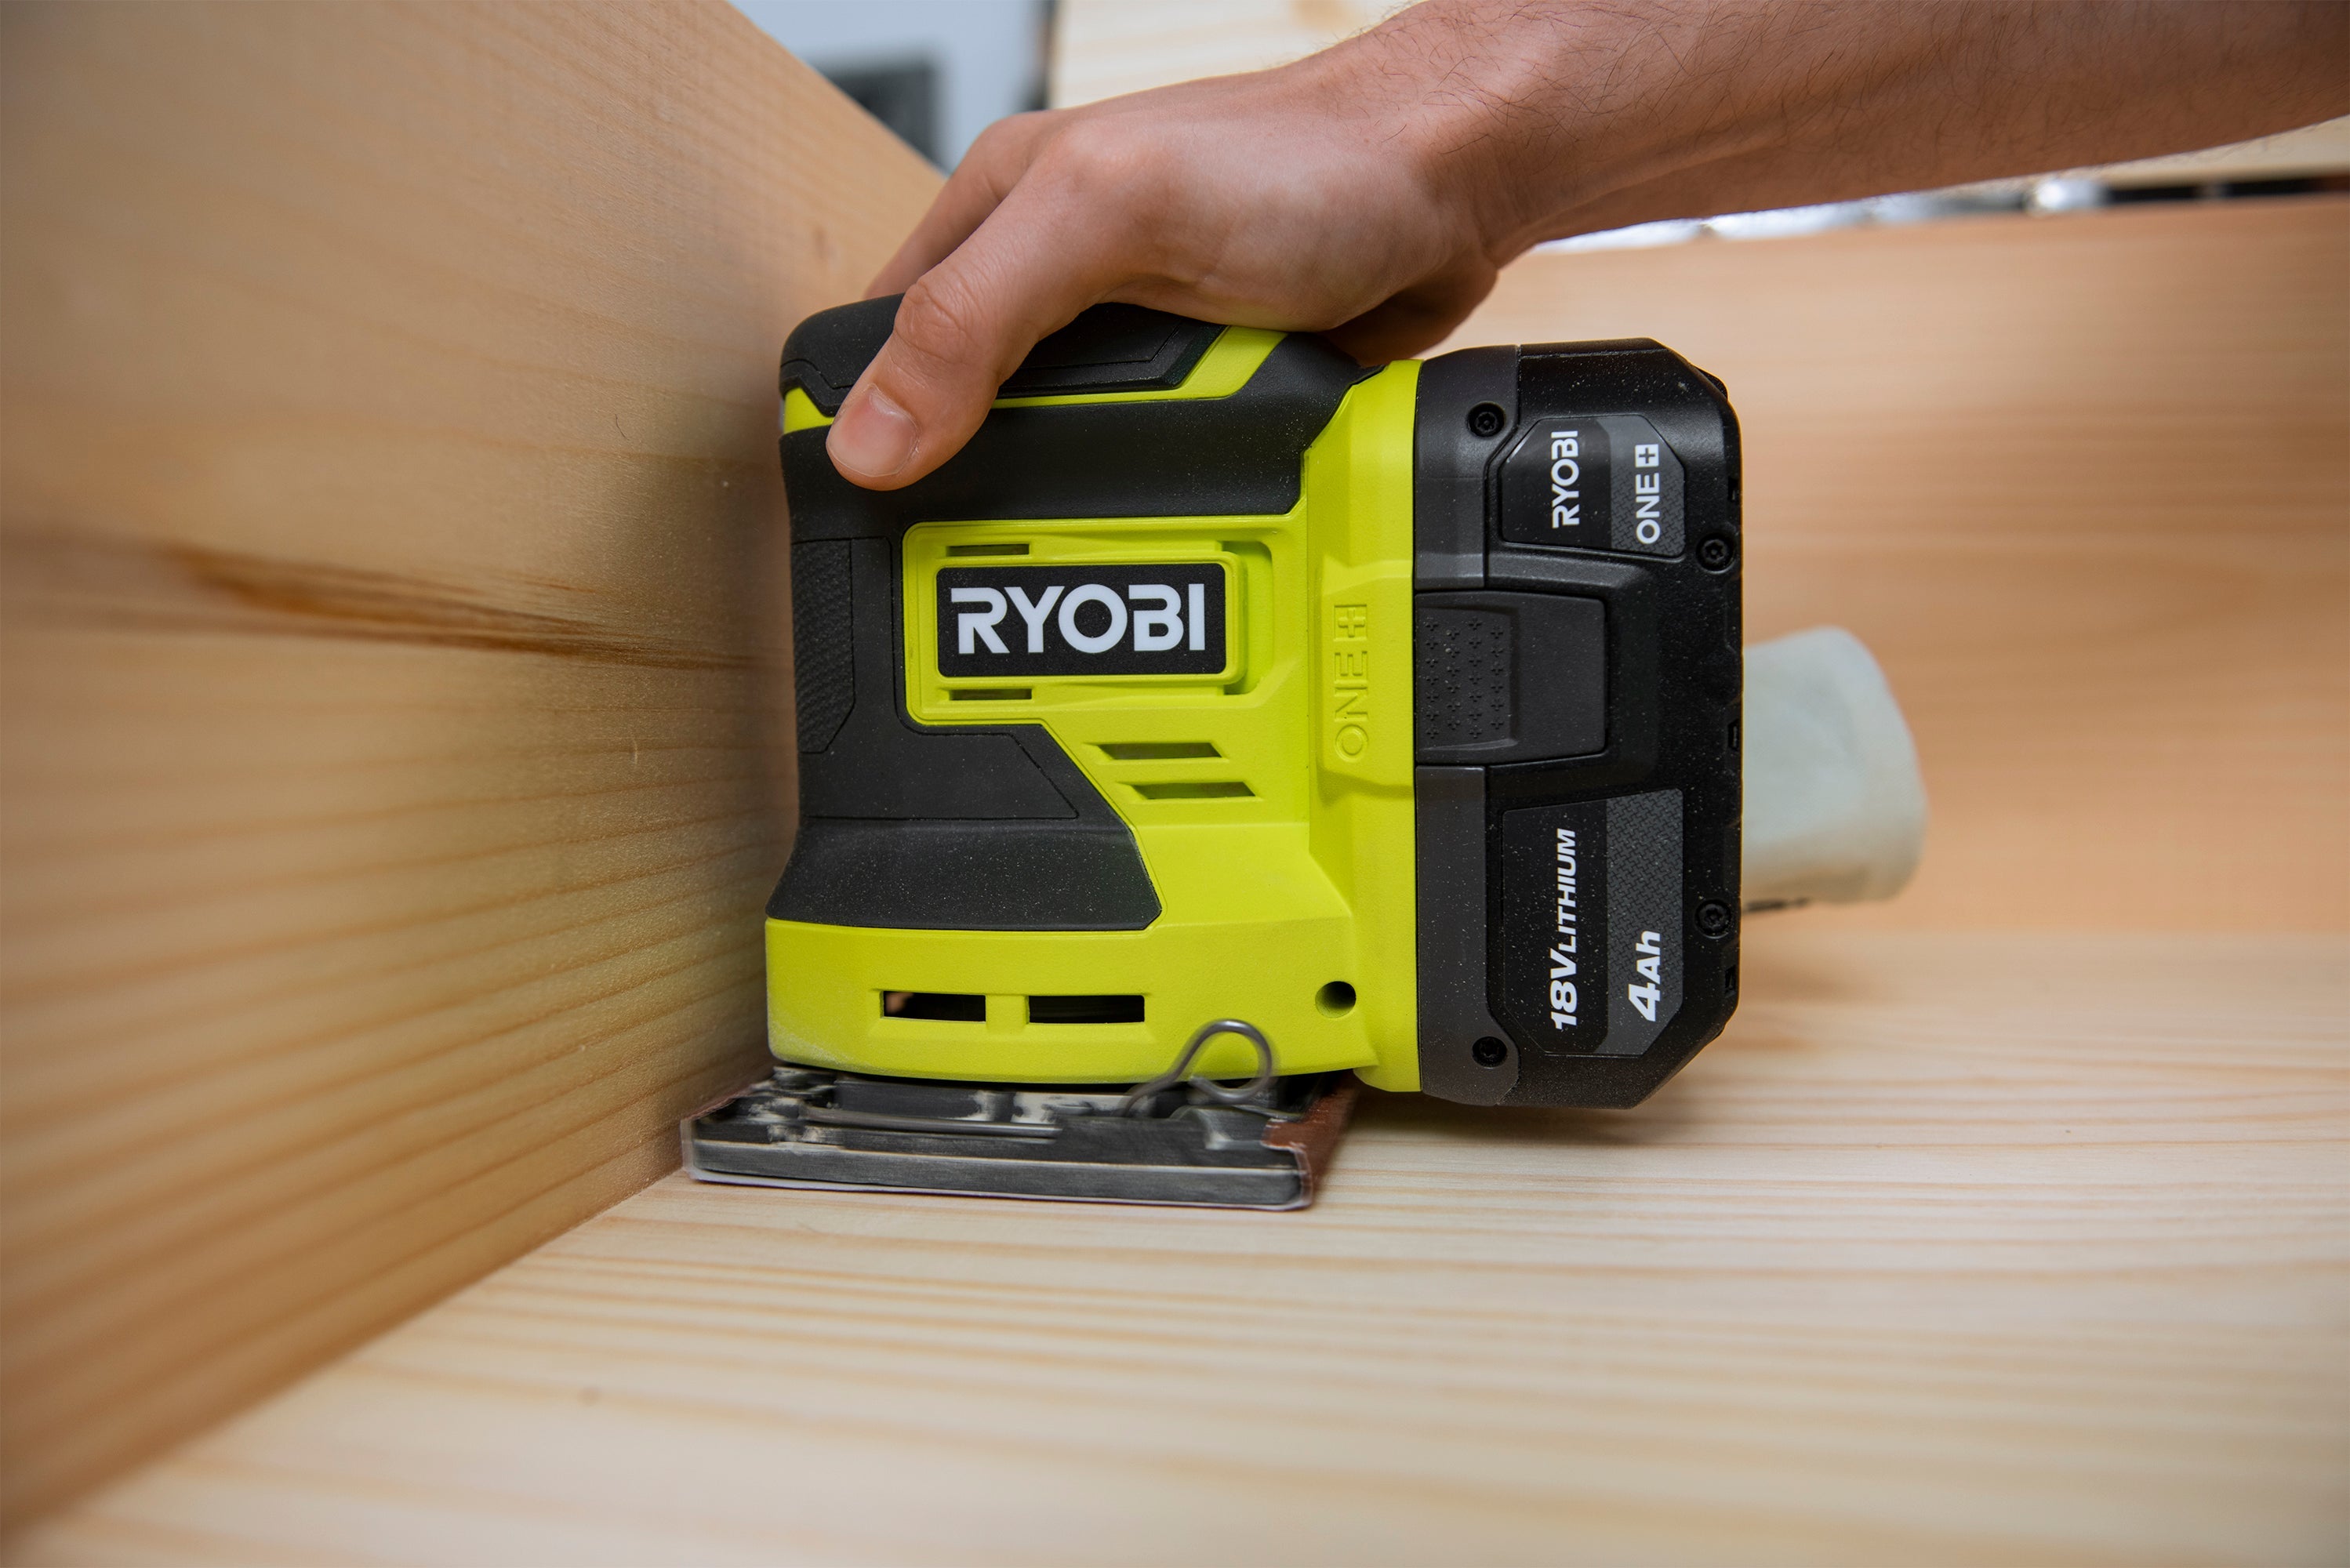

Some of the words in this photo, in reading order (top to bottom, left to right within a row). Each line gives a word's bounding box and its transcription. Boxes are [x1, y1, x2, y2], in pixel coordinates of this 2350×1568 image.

[1550, 430, 1580, 529] RYOBI
[951, 583, 1205, 654] RYOBI
[1628, 931, 1661, 1022] 4Ah
